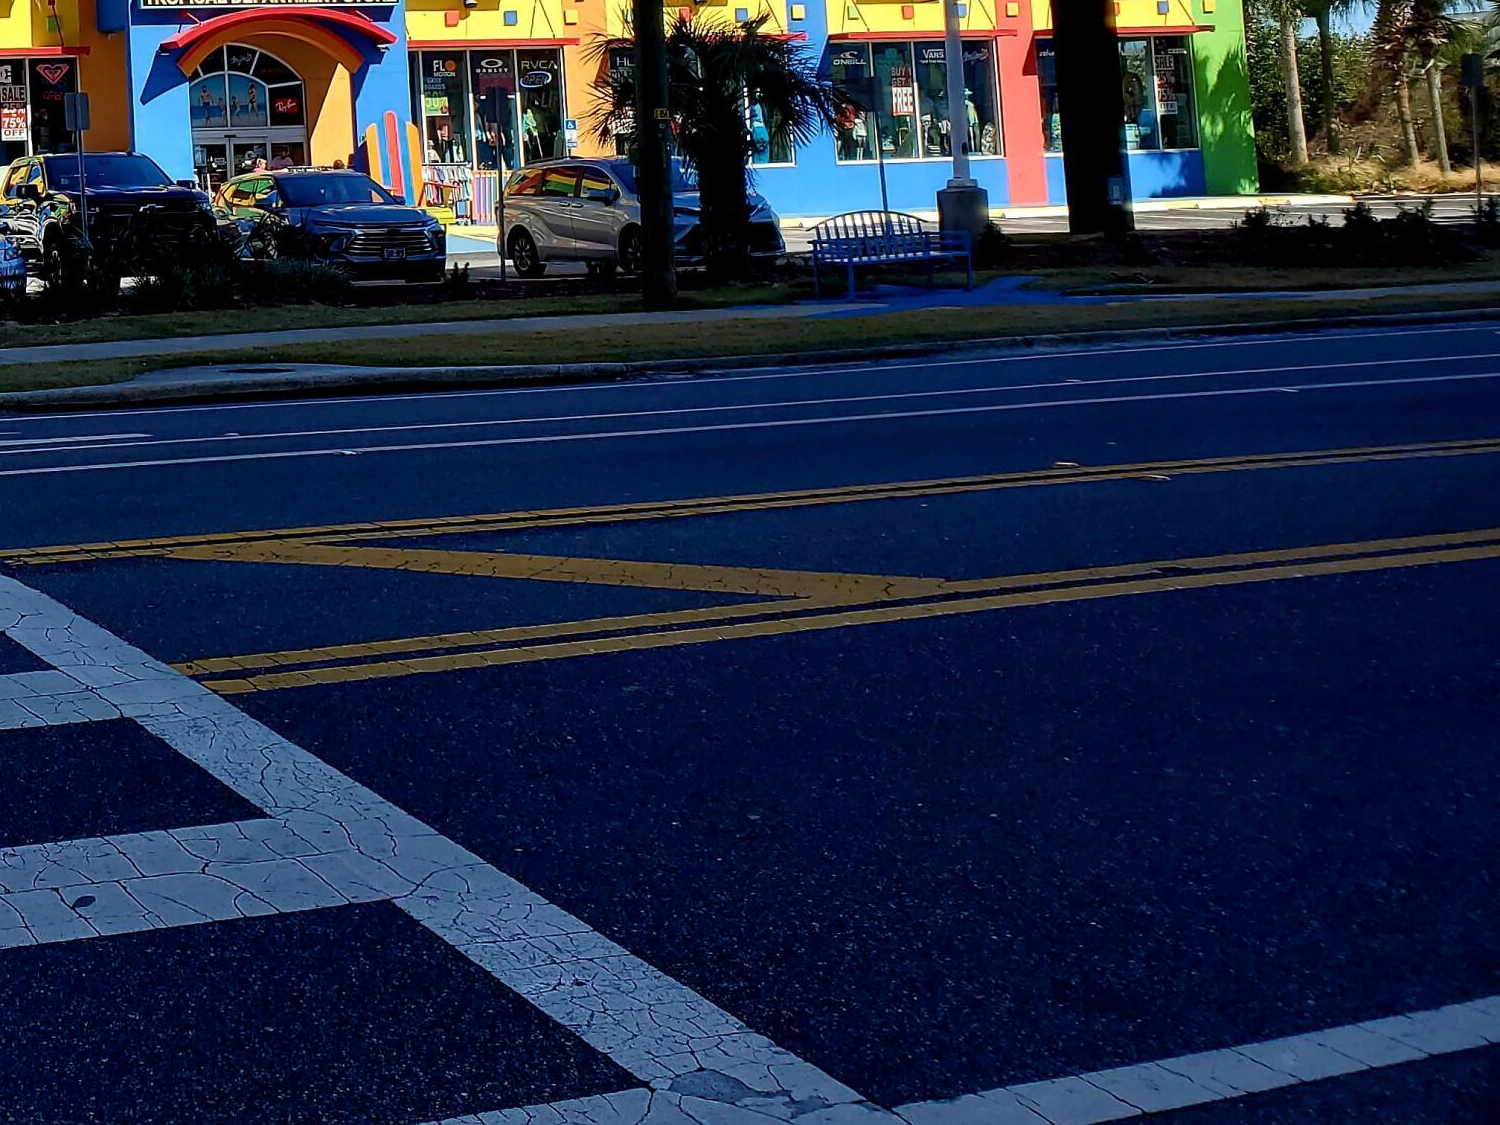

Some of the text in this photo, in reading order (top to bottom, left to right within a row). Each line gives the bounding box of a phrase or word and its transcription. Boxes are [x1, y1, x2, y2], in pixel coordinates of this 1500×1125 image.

[891, 67, 906, 76] BUY
[892, 77, 906, 87] GET
[2, 87, 25, 101] SALE
[893, 88, 914, 112] FREE
[3, 117, 26, 128] 75%
